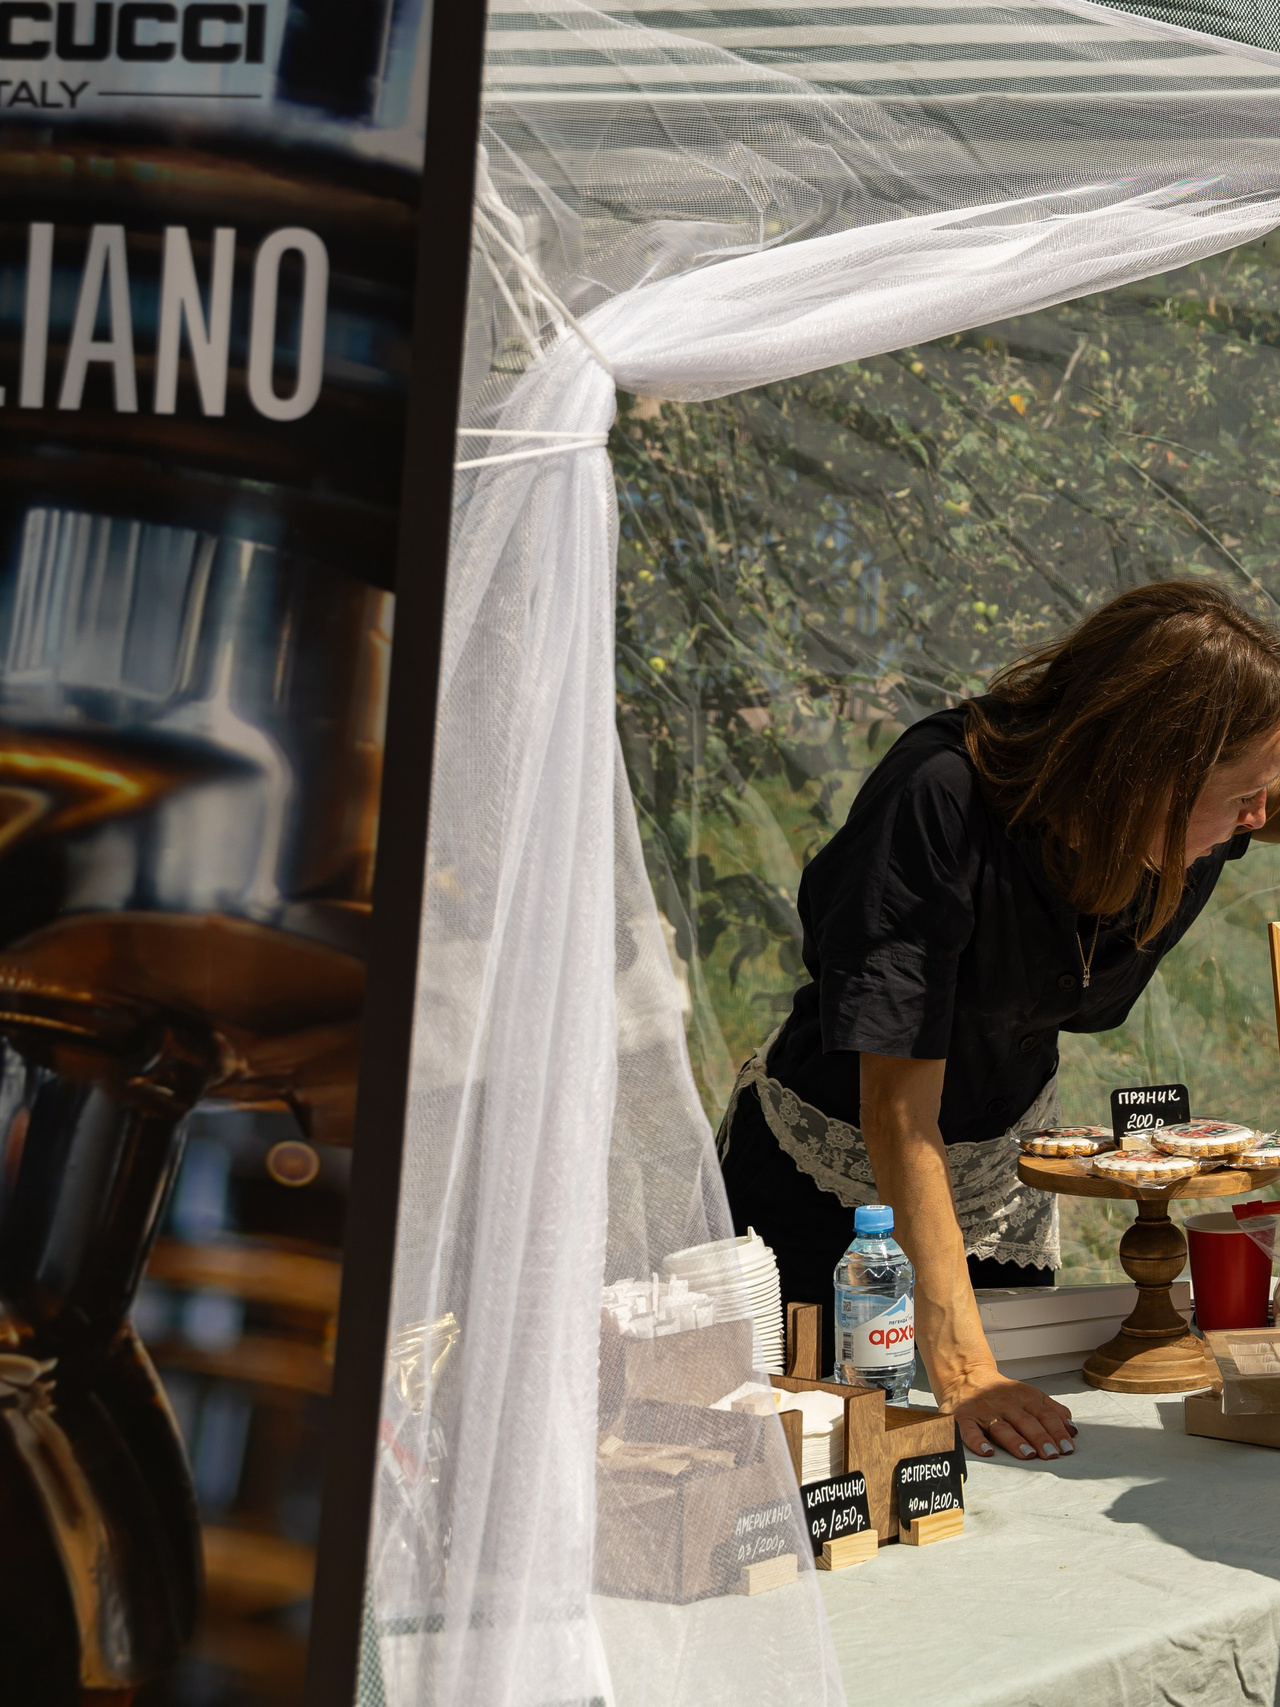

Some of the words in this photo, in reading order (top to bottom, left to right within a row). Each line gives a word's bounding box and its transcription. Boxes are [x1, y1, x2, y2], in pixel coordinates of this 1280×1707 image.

[0, 222, 330, 421] IANO
[1118, 1089, 1181, 1105] ПРЯНИК
[901, 1460, 951, 1484] ЭСПРЕССО
[806, 1477, 866, 1509] КАПУЧИНО
